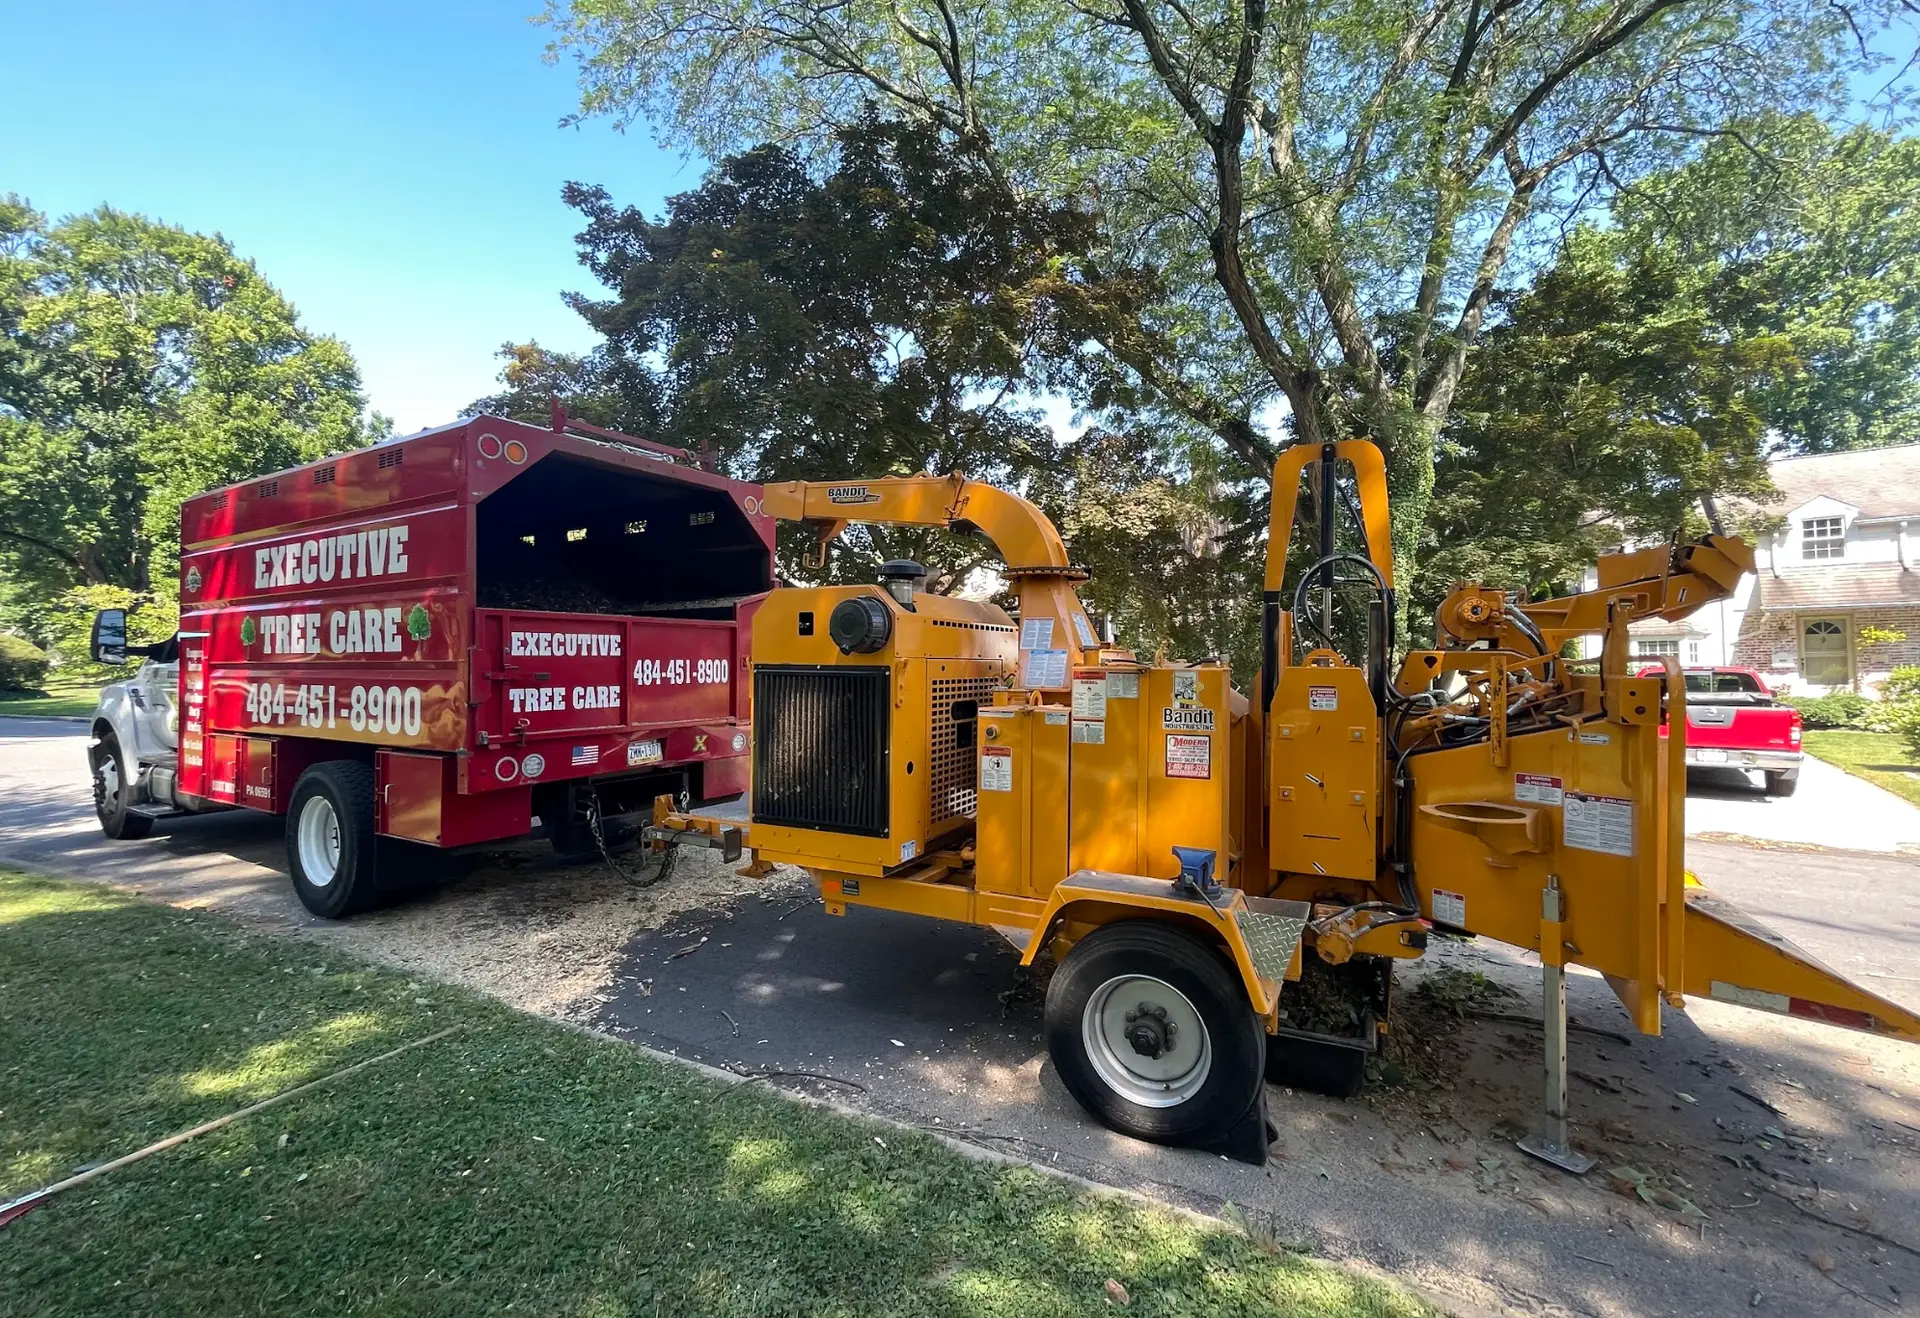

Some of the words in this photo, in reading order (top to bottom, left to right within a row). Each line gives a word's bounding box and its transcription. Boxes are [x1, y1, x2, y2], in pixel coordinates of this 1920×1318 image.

[828, 487, 867, 497] BANDIT
[255, 525, 409, 589] EXECUTIVE
[260, 613, 321, 655] TREE
[330, 607, 402, 654] CARE
[510, 631, 621, 656] EXECUTIVE
[633, 659, 729, 686] 484-451-8900
[246, 683, 421, 736] 484-451-8900
[509, 687, 566, 713] TREE
[572, 686, 620, 709] CARE
[1163, 708, 1214, 723] Bandit
